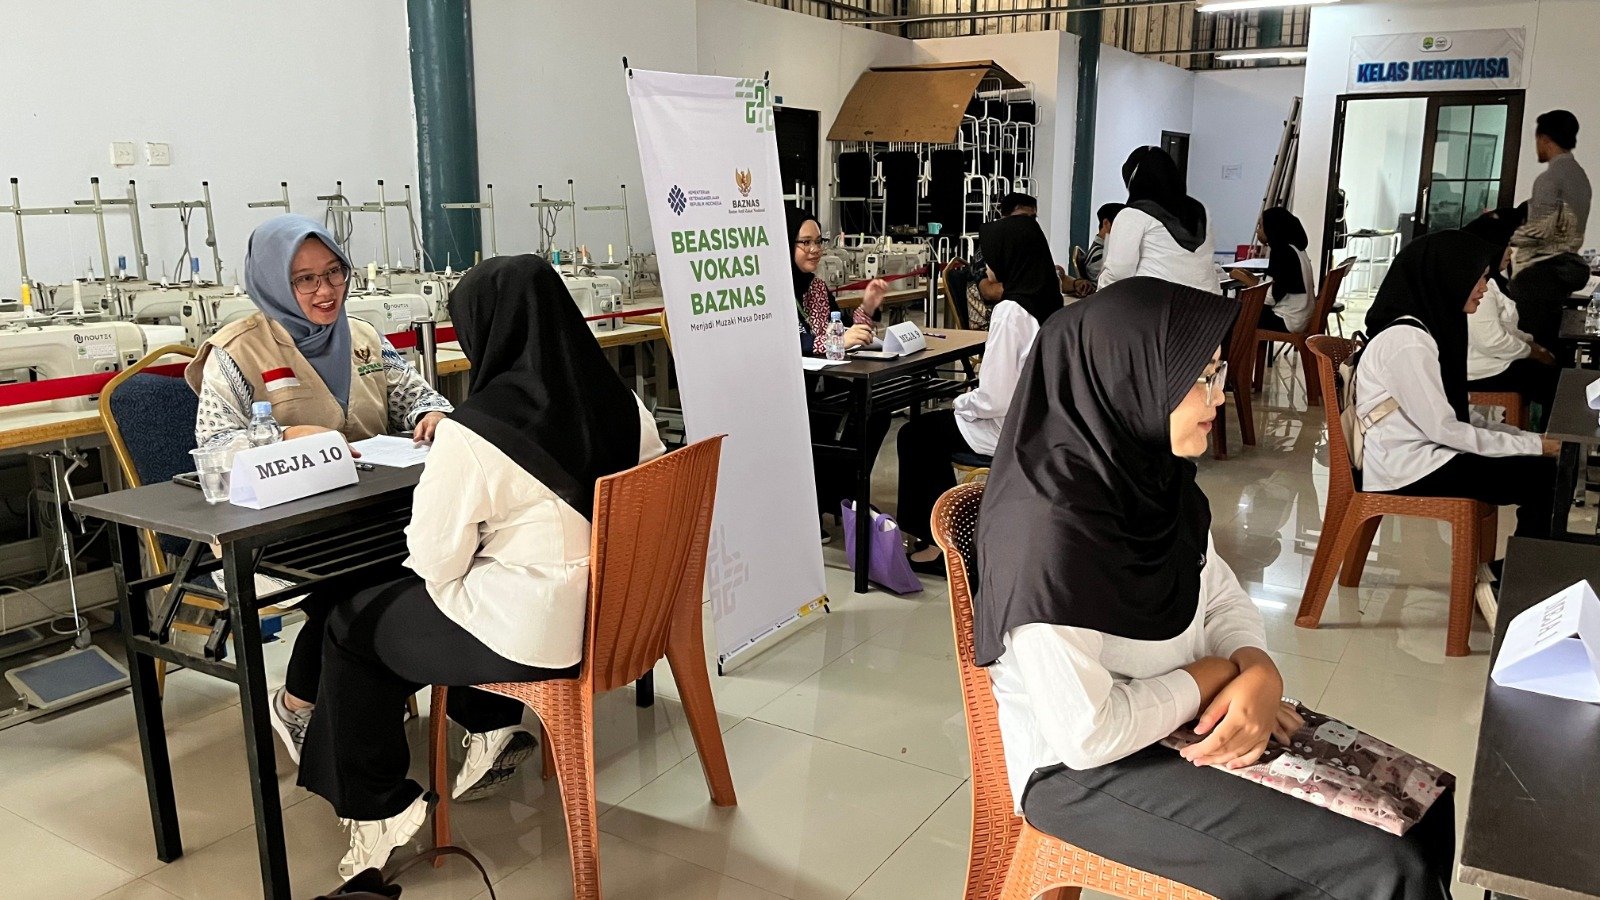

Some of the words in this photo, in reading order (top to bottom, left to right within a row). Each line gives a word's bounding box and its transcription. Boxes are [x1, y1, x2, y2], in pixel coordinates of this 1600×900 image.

[1357, 62, 1409, 82] KELAS
[1411, 57, 1509, 80] KERTAYASA
[732, 199, 760, 208] BAZNAS
[671, 226, 769, 254] BEASISWA
[690, 255, 760, 282] VOKASI
[691, 285, 766, 315] BAZNAS
[690, 322, 715, 332] Menjadi
[715, 317, 737, 327] Muzaki
[737, 316, 752, 324] Masa
[753, 312, 773, 322] Depan
[899, 332, 916, 343] MEJA
[255, 453, 315, 480] MEJA
[319, 446, 343, 464] 10
